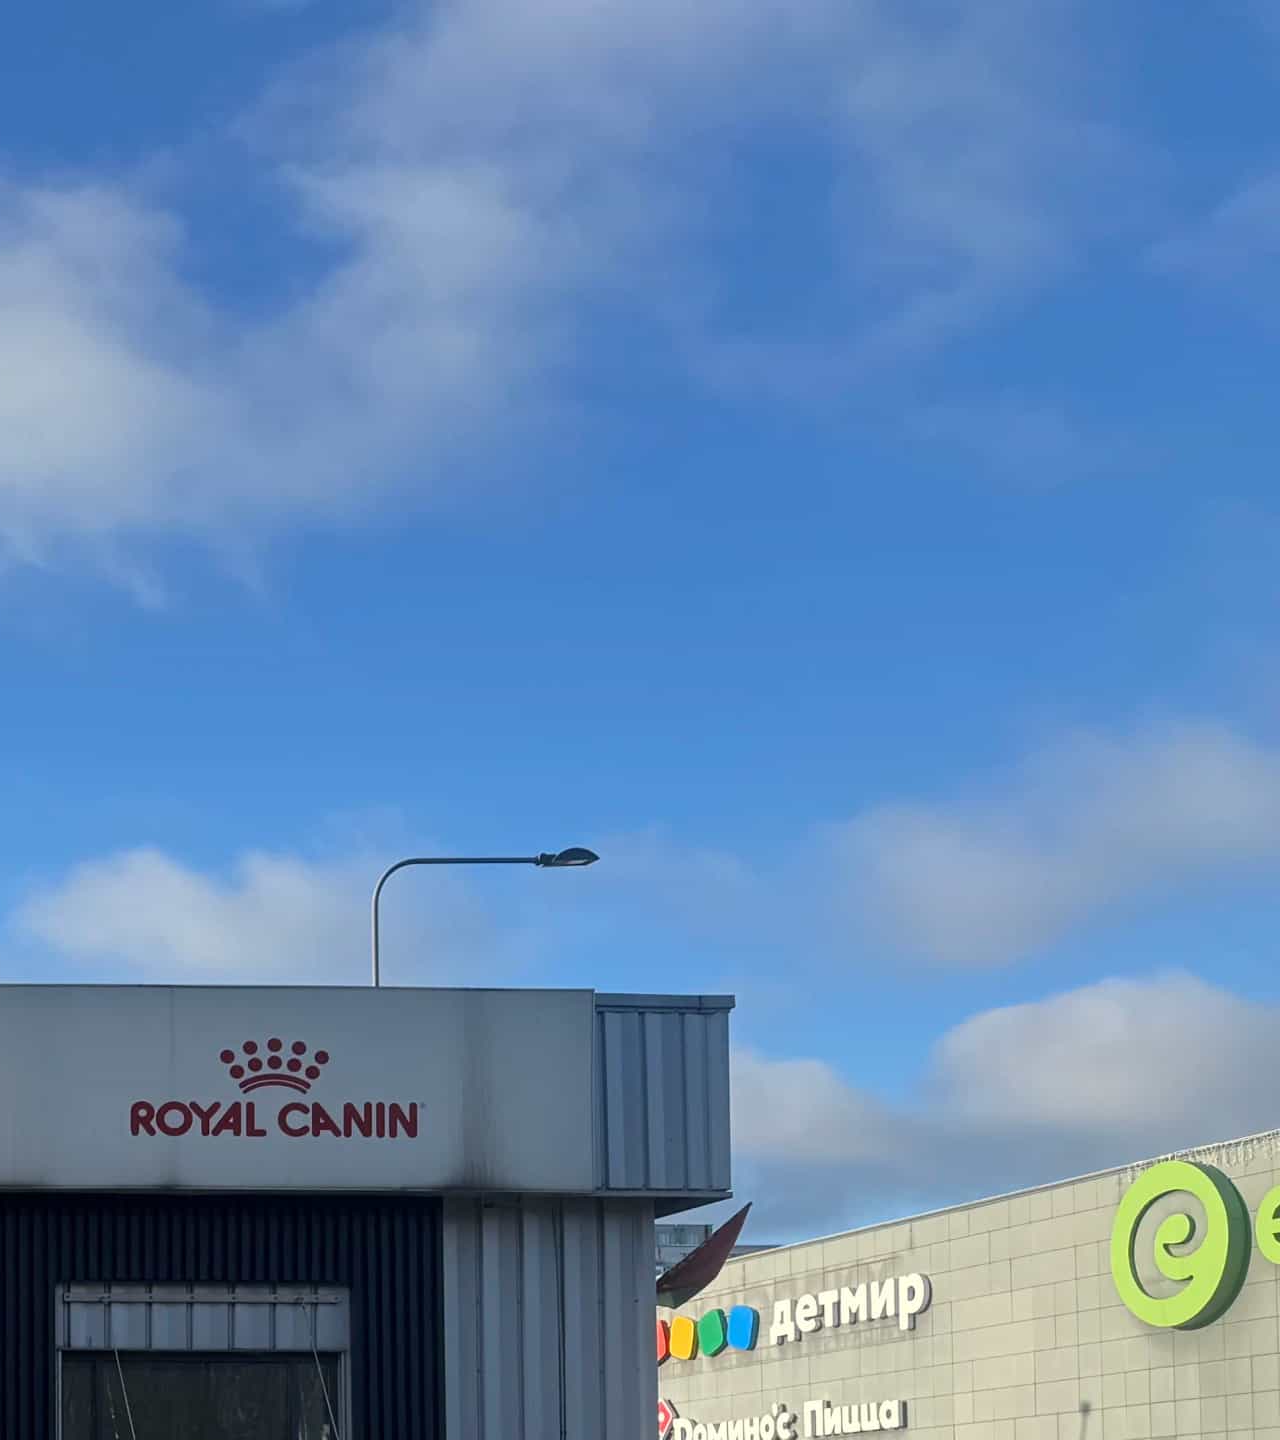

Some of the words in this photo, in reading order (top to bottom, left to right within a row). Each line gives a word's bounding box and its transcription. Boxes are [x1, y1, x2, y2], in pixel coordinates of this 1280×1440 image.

[130, 1101, 267, 1137] ROYAL
[770, 1273, 928, 1345] детмир
[803, 1400, 902, 1438] Пицца
